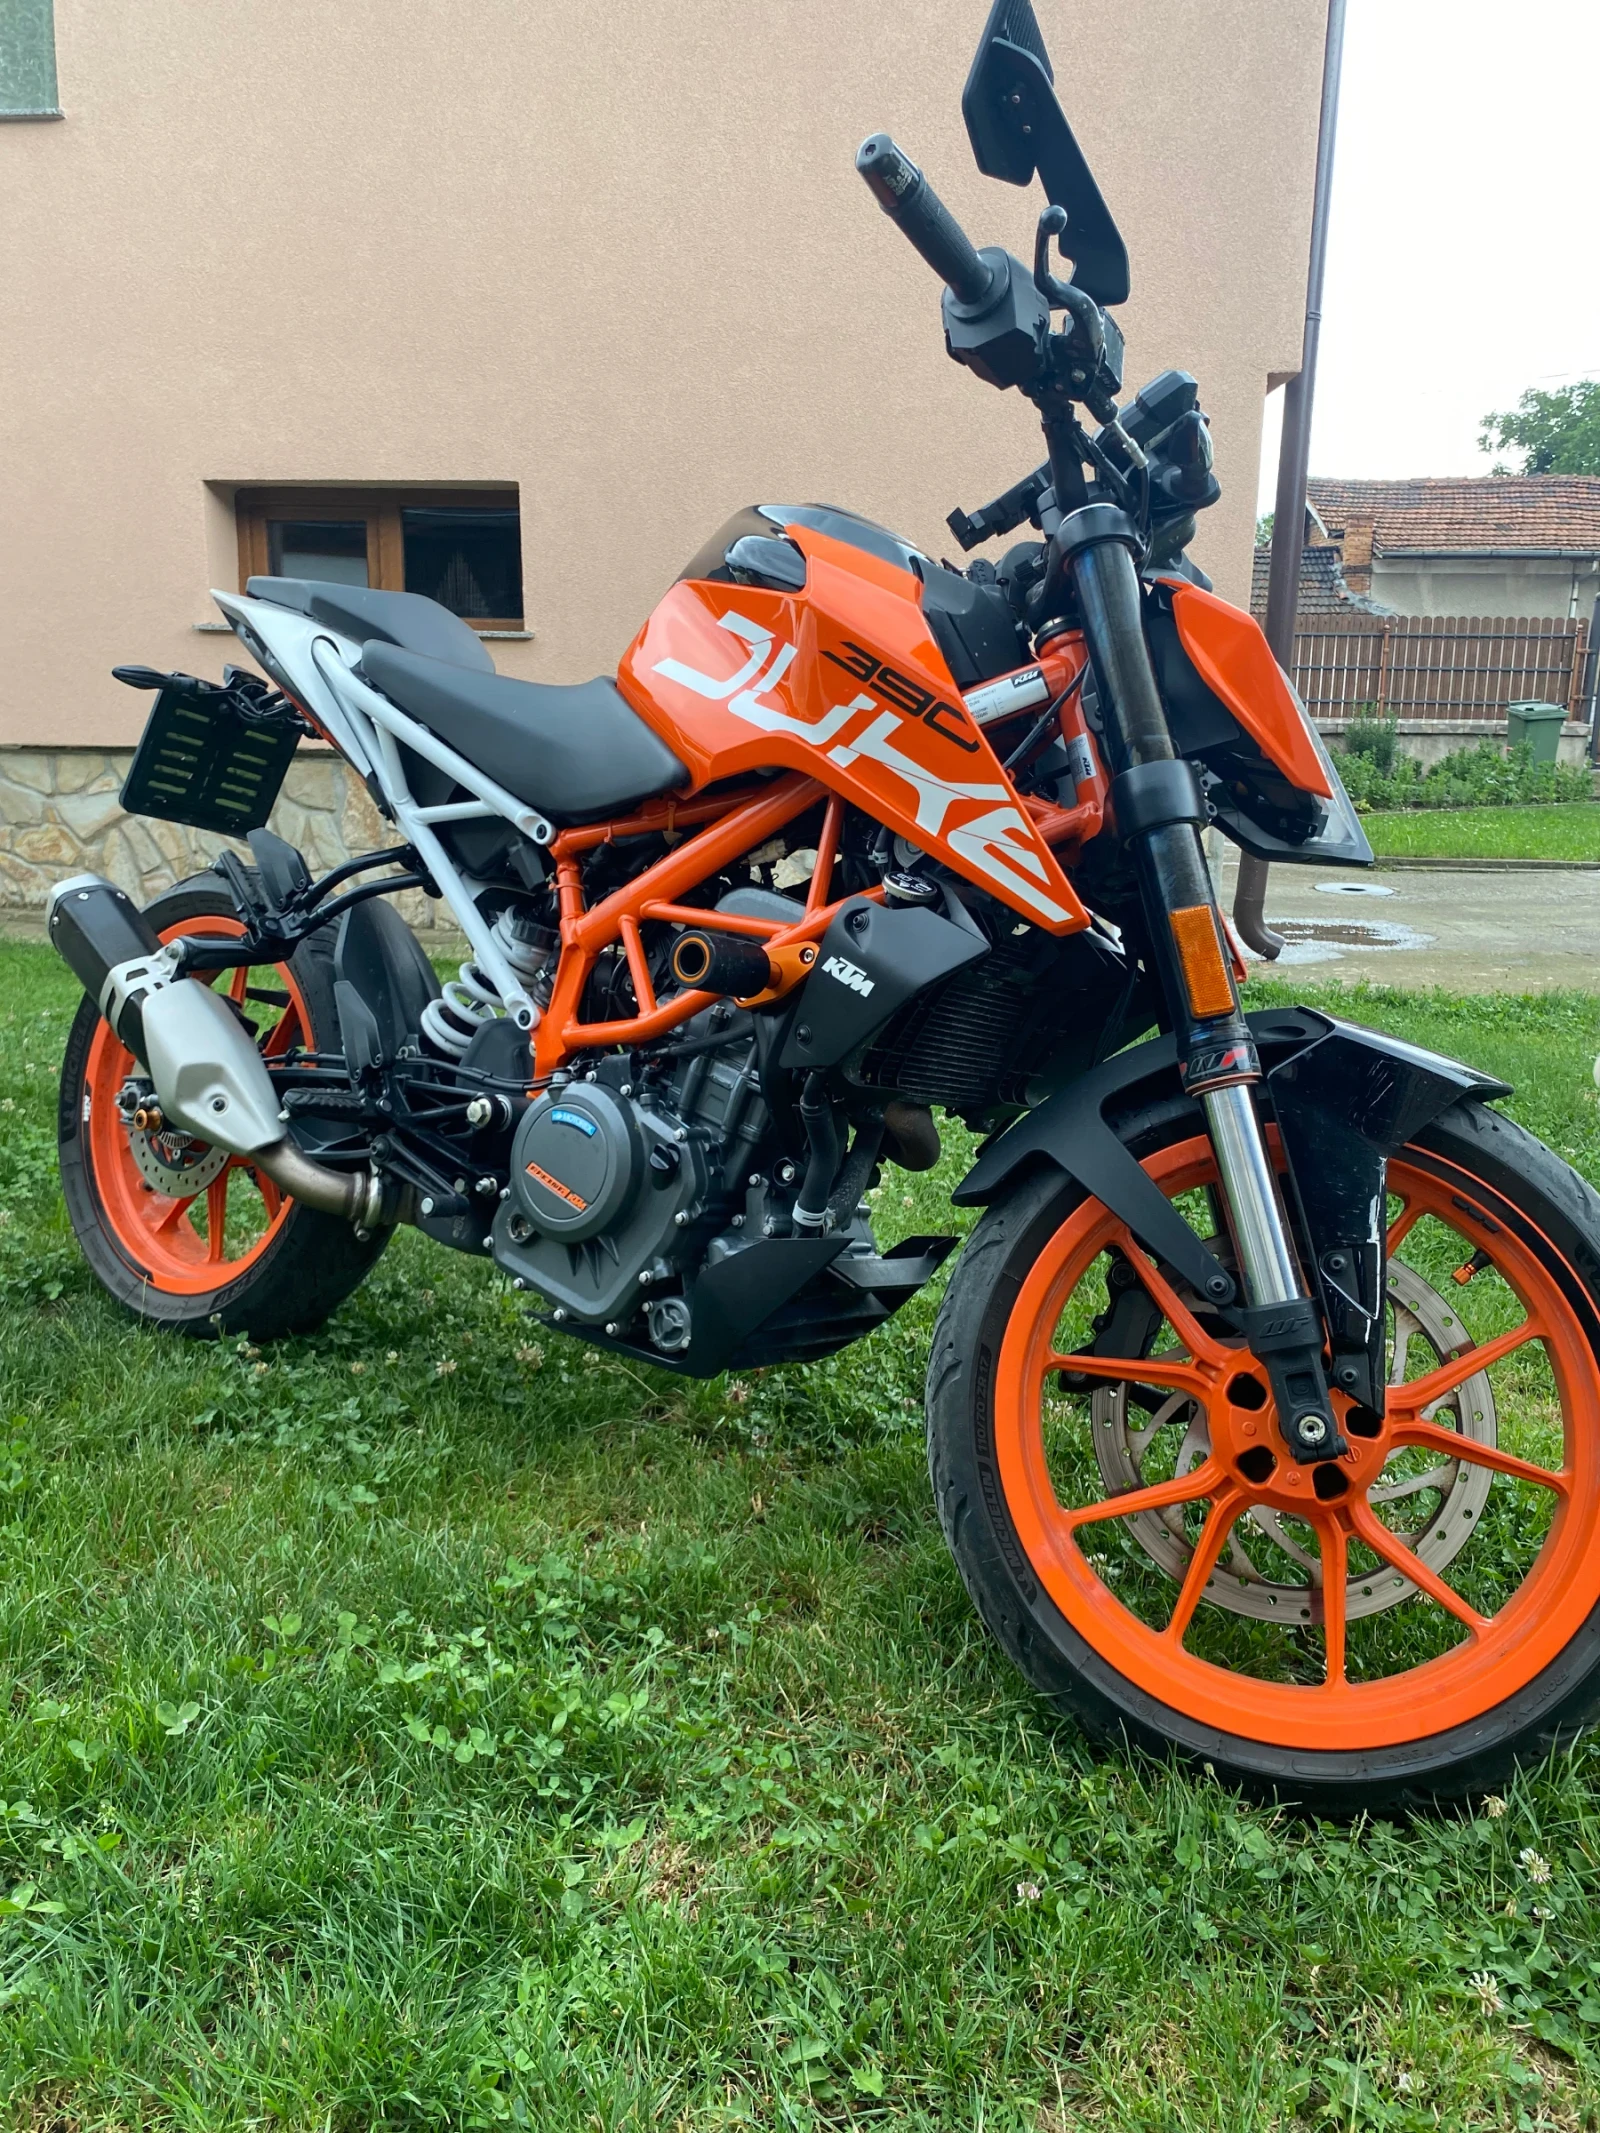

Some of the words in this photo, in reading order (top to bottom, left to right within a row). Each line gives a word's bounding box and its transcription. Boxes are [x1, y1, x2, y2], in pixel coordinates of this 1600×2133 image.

[1014, 670, 1039, 686] KTM
[1082, 756, 1092, 776] KTM
[821, 956, 876, 998] KTM
[981, 1470, 1023, 1568] MICHELIN
